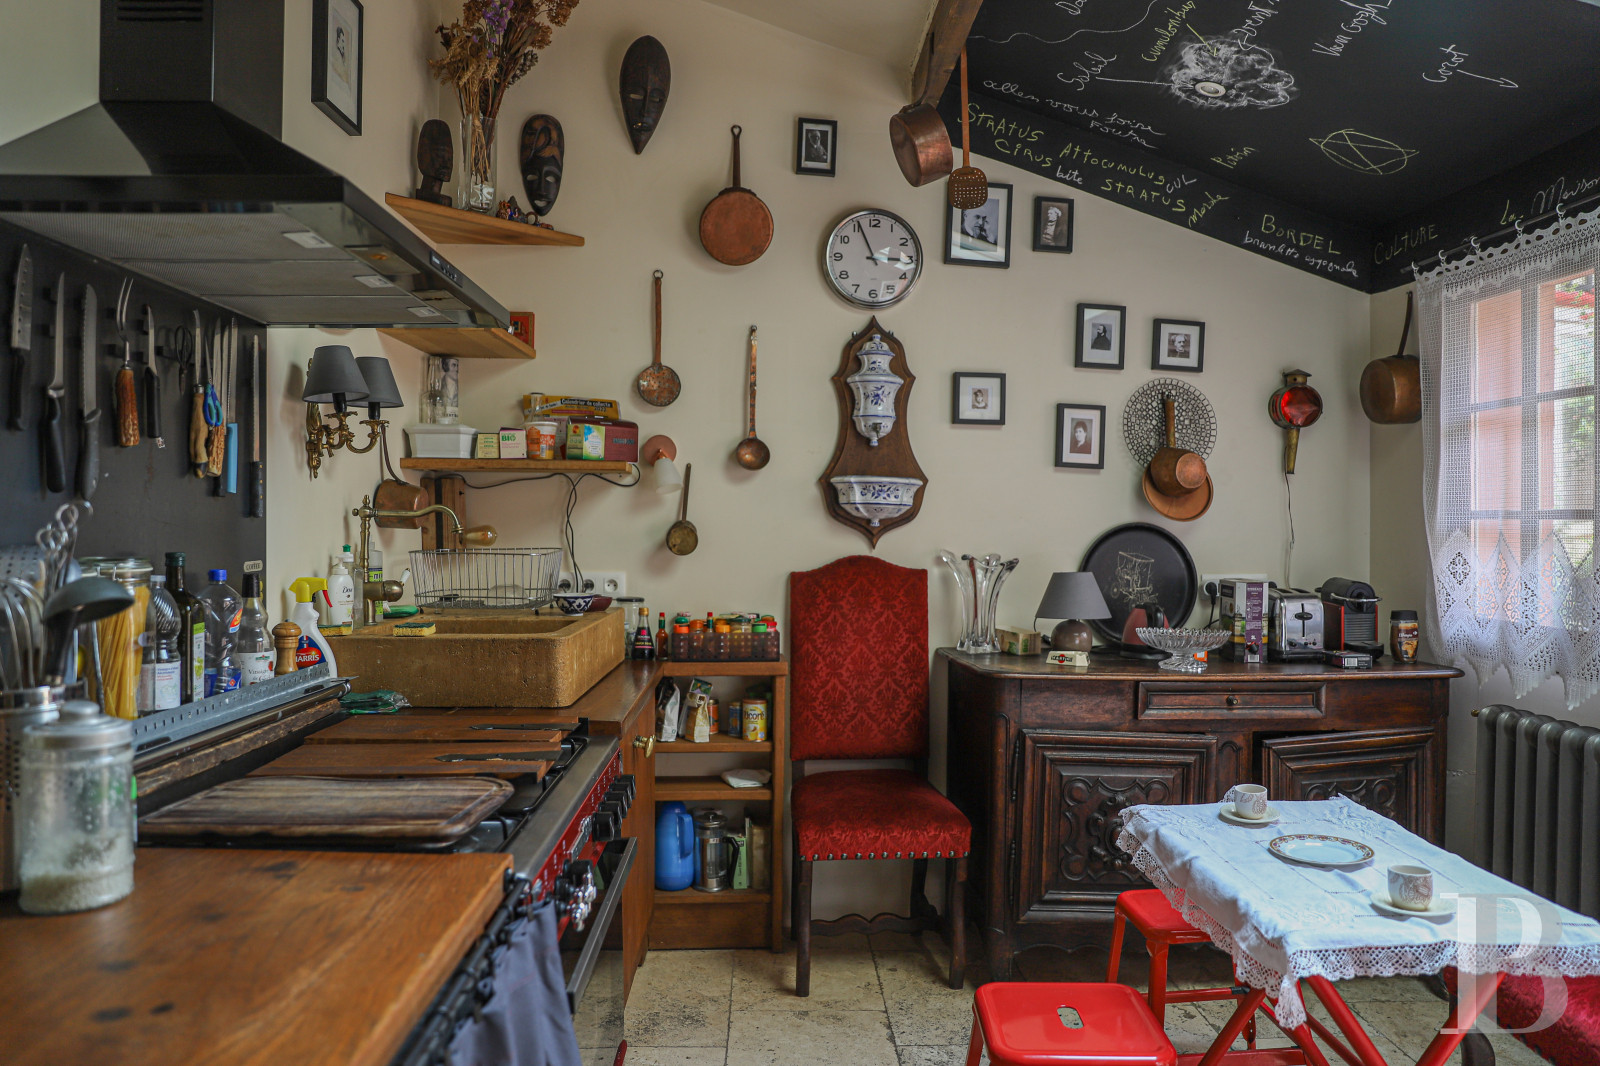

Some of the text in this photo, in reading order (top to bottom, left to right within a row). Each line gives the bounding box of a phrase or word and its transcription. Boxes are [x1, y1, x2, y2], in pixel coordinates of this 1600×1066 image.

[1056, 165, 1083, 185] bite
[853, 223, 860, 233] 11
[869, 218, 881, 228] 12
[840, 235, 850, 244] 10
[899, 237, 909, 247] 2
[833, 252, 843, 262] 9
[905, 255, 914, 265] 3
[839, 270, 849, 280] 8
[898, 272, 907, 280] 4
[852, 283, 860, 293] 7
[886, 285, 896, 294] 5
[868, 289, 878, 299] 6
